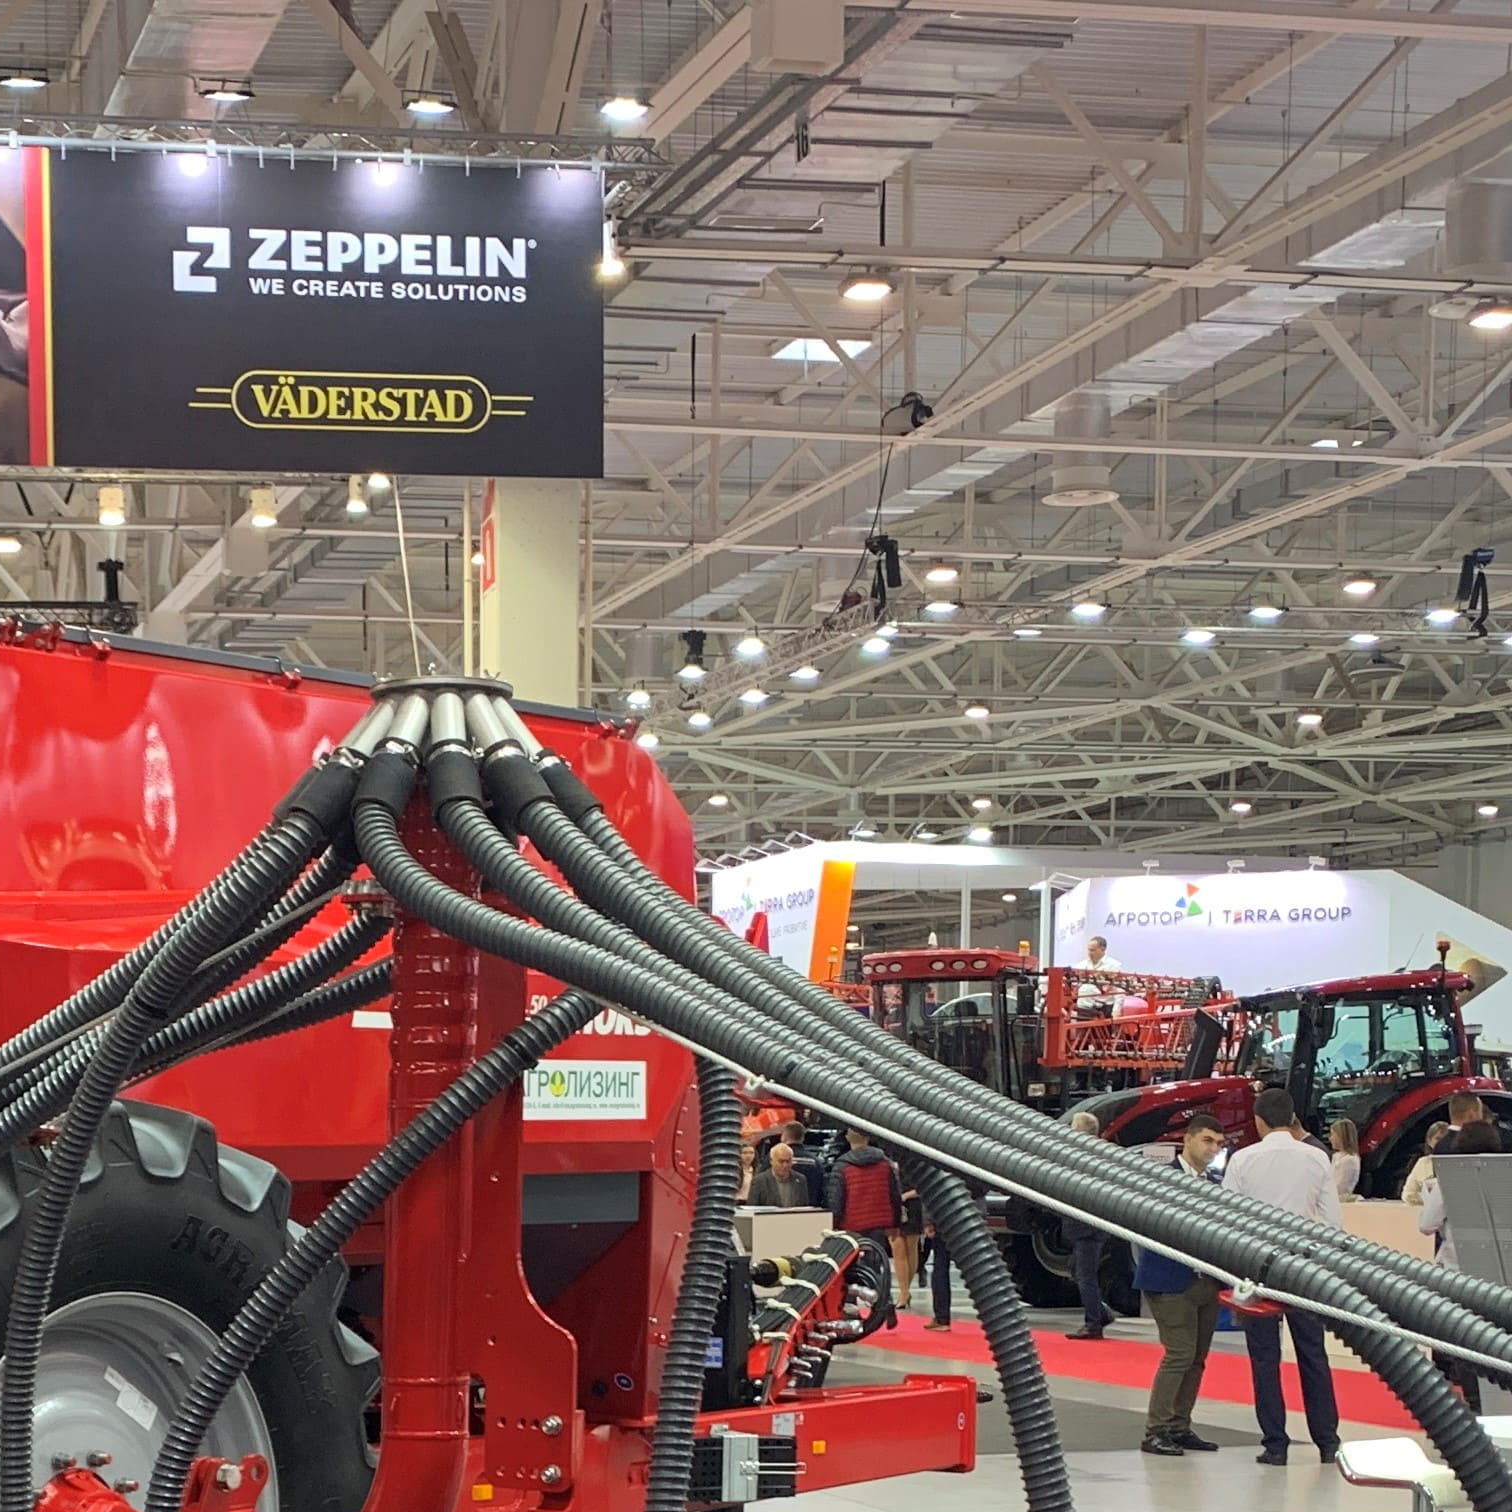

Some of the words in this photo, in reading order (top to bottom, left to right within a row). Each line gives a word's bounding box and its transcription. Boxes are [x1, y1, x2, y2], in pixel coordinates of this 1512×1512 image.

[248, 228, 527, 278] ZEPPELIN
[249, 277, 285, 295] WE
[292, 279, 384, 299] CREATE
[391, 283, 527, 303] SOLUTIONS
[251, 376, 472, 423] VÄDERSTAD
[1104, 909, 1184, 928] АГРОТОР
[1288, 906, 1352, 922] GROUP
[525, 1070, 641, 1098] ГРОЛИЗИНГ
